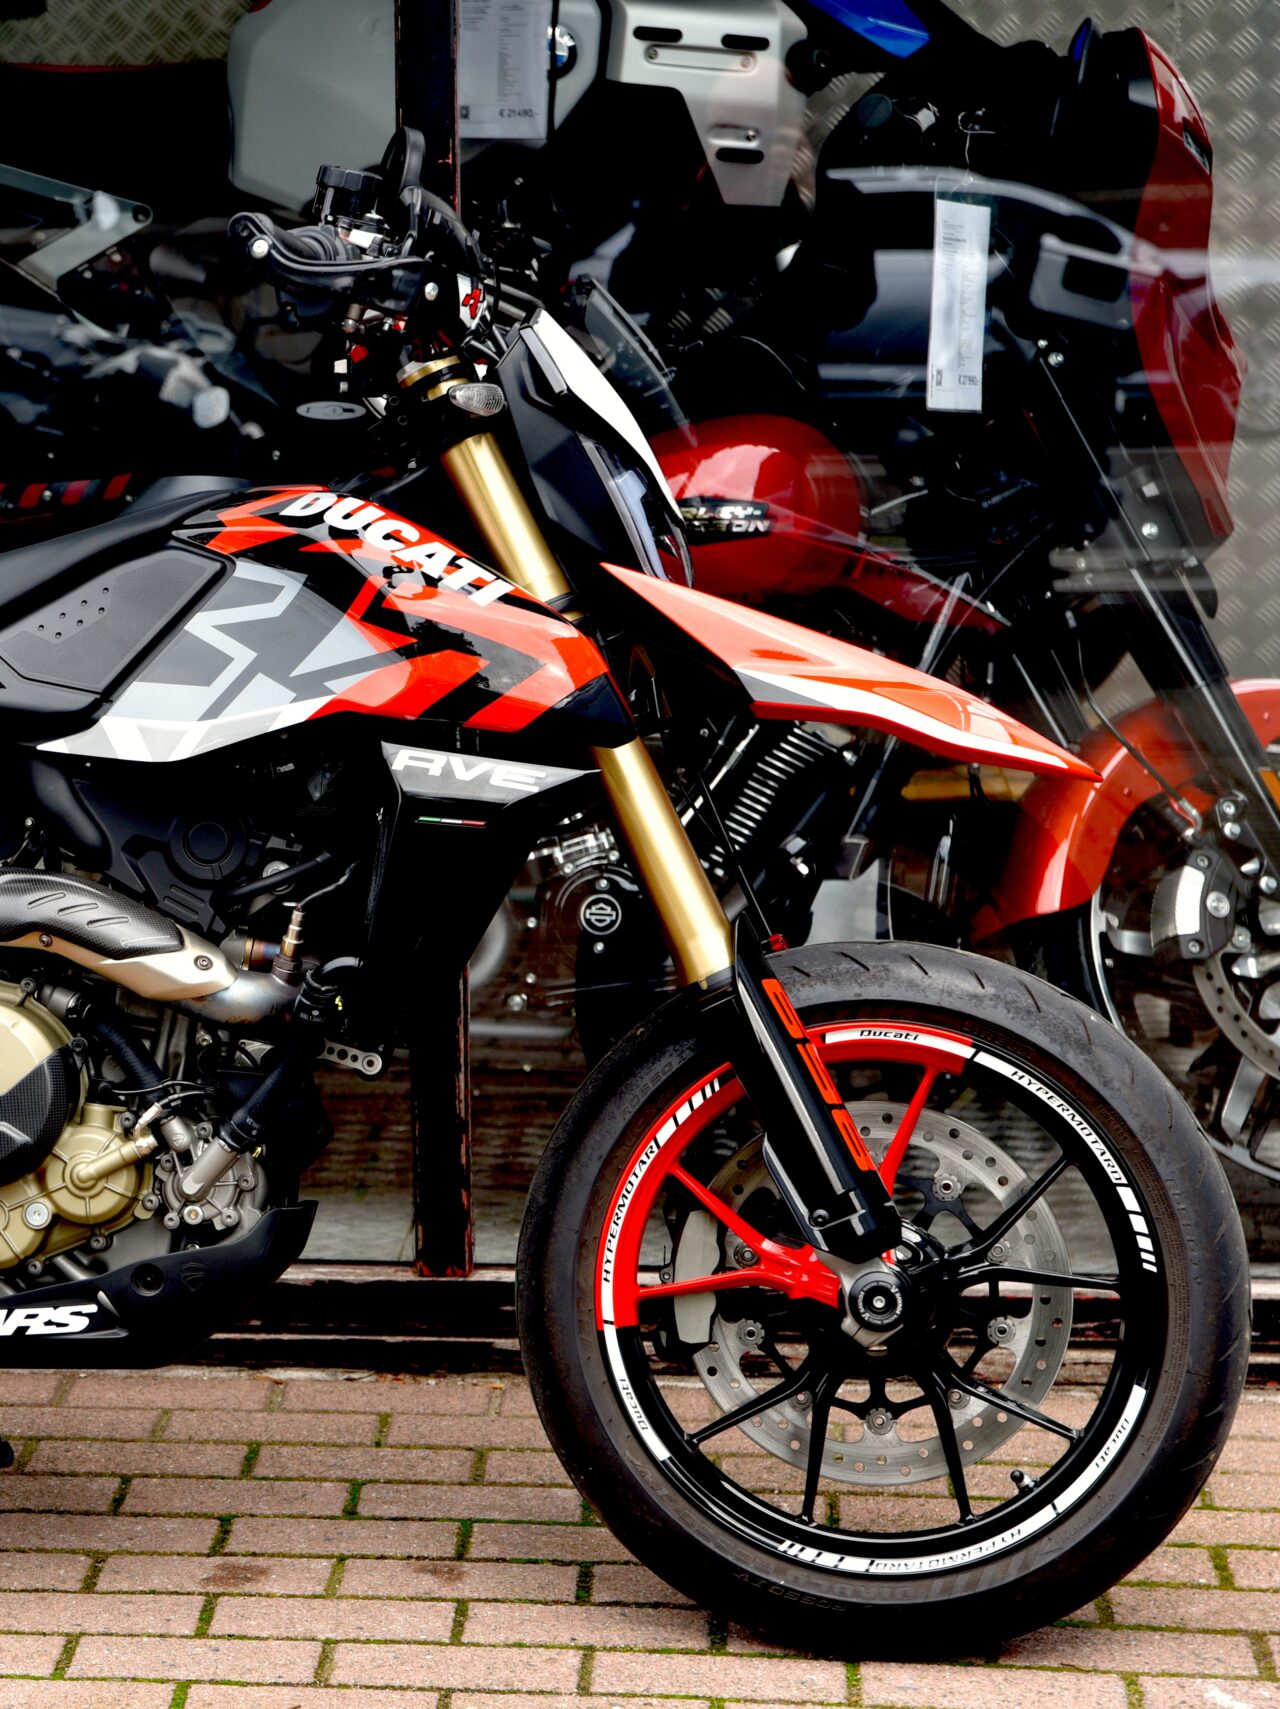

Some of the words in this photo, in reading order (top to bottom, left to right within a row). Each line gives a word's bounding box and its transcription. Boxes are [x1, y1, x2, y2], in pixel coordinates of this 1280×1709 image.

[279, 492, 516, 607] DUCATI
[391, 749, 547, 793] RVE
[860, 1029, 919, 1041] Ducati
[1011, 1071, 1123, 1182] HYPERMOTARD
[603, 1144, 656, 1283] HYPERMOTAR
[619, 1378, 649, 1431] Ducati
[1095, 1417, 1130, 1469] Ducati
[876, 1528, 1022, 1571] HYPERMOTARD
